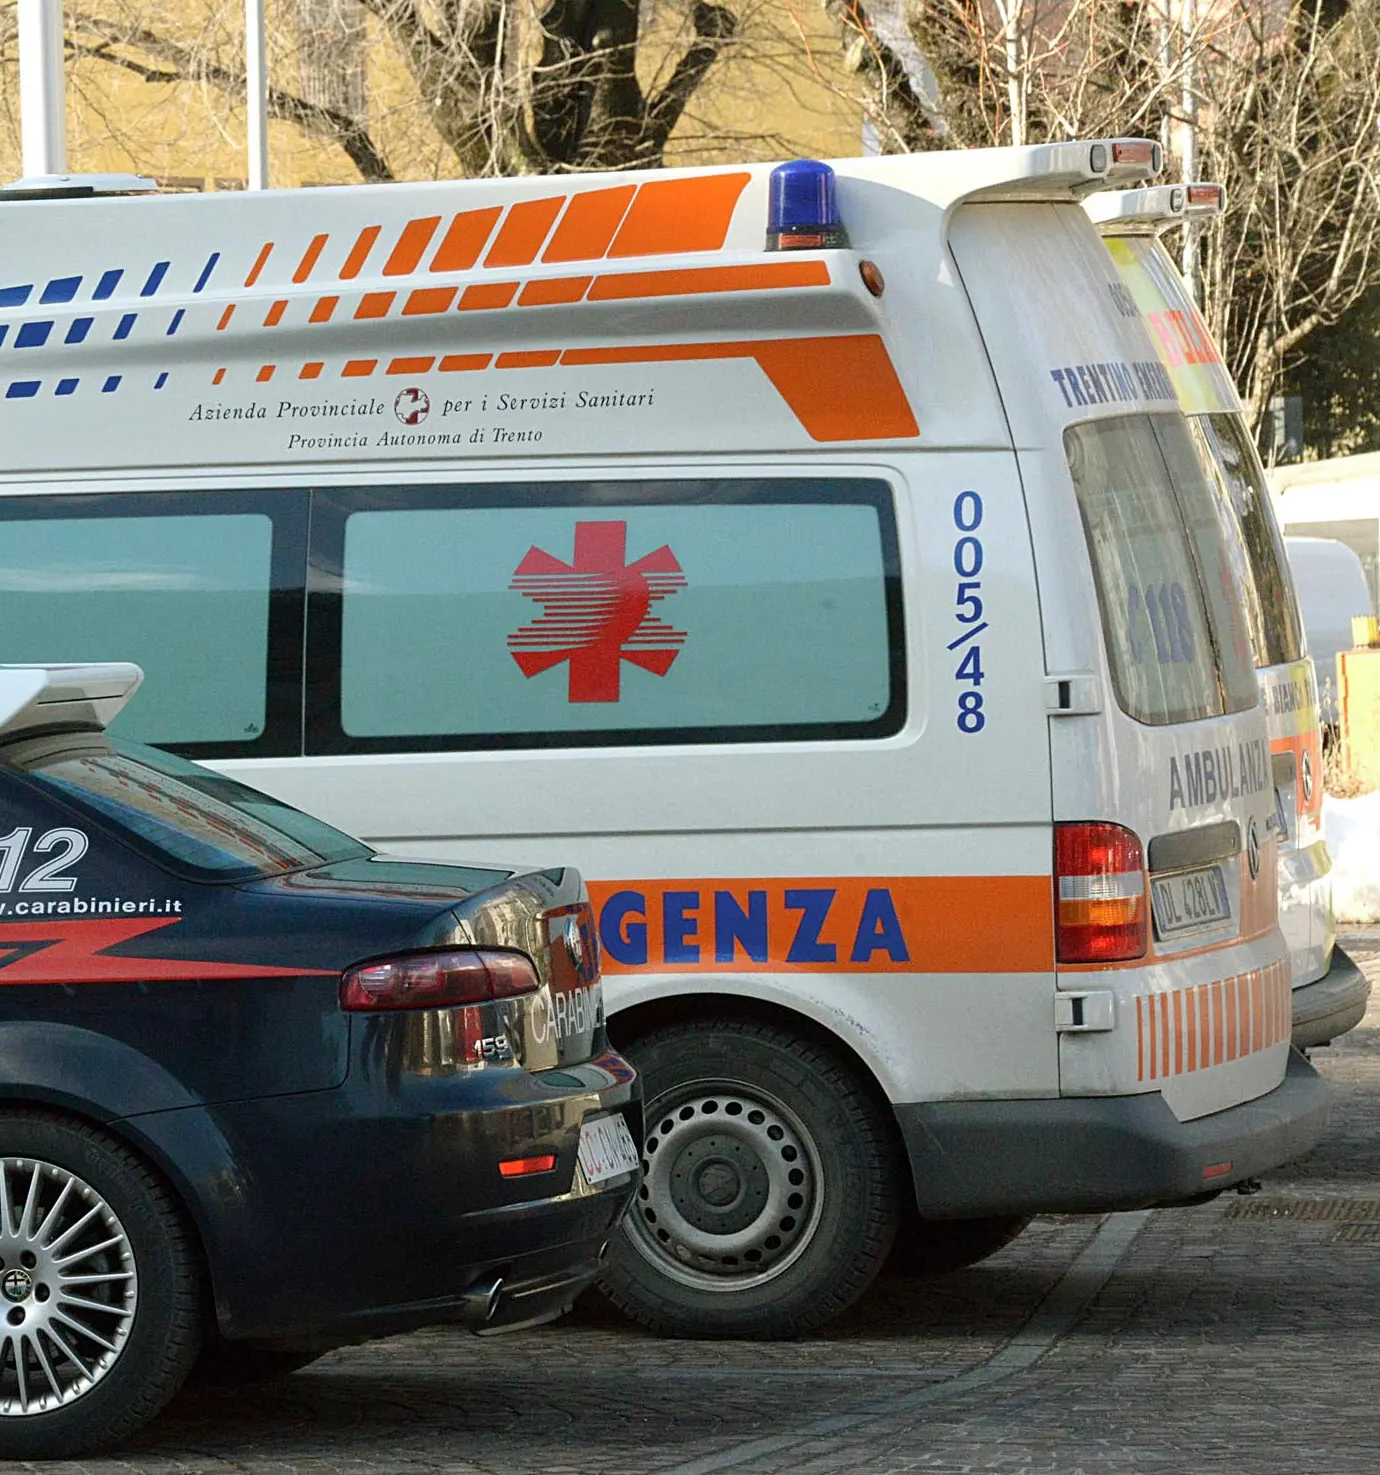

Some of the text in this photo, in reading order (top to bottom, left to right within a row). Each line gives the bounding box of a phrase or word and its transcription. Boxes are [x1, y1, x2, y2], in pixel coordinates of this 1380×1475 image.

[187, 387, 656, 421] Azienda Provinciale per i Servizi Sanitari
[287, 426, 543, 449] Provincia Autonoma di Trento
[946, 490, 989, 735] 005/48
[1160, 868, 1225, 925] DL 428LV
[472, 1034, 509, 1058] 159
